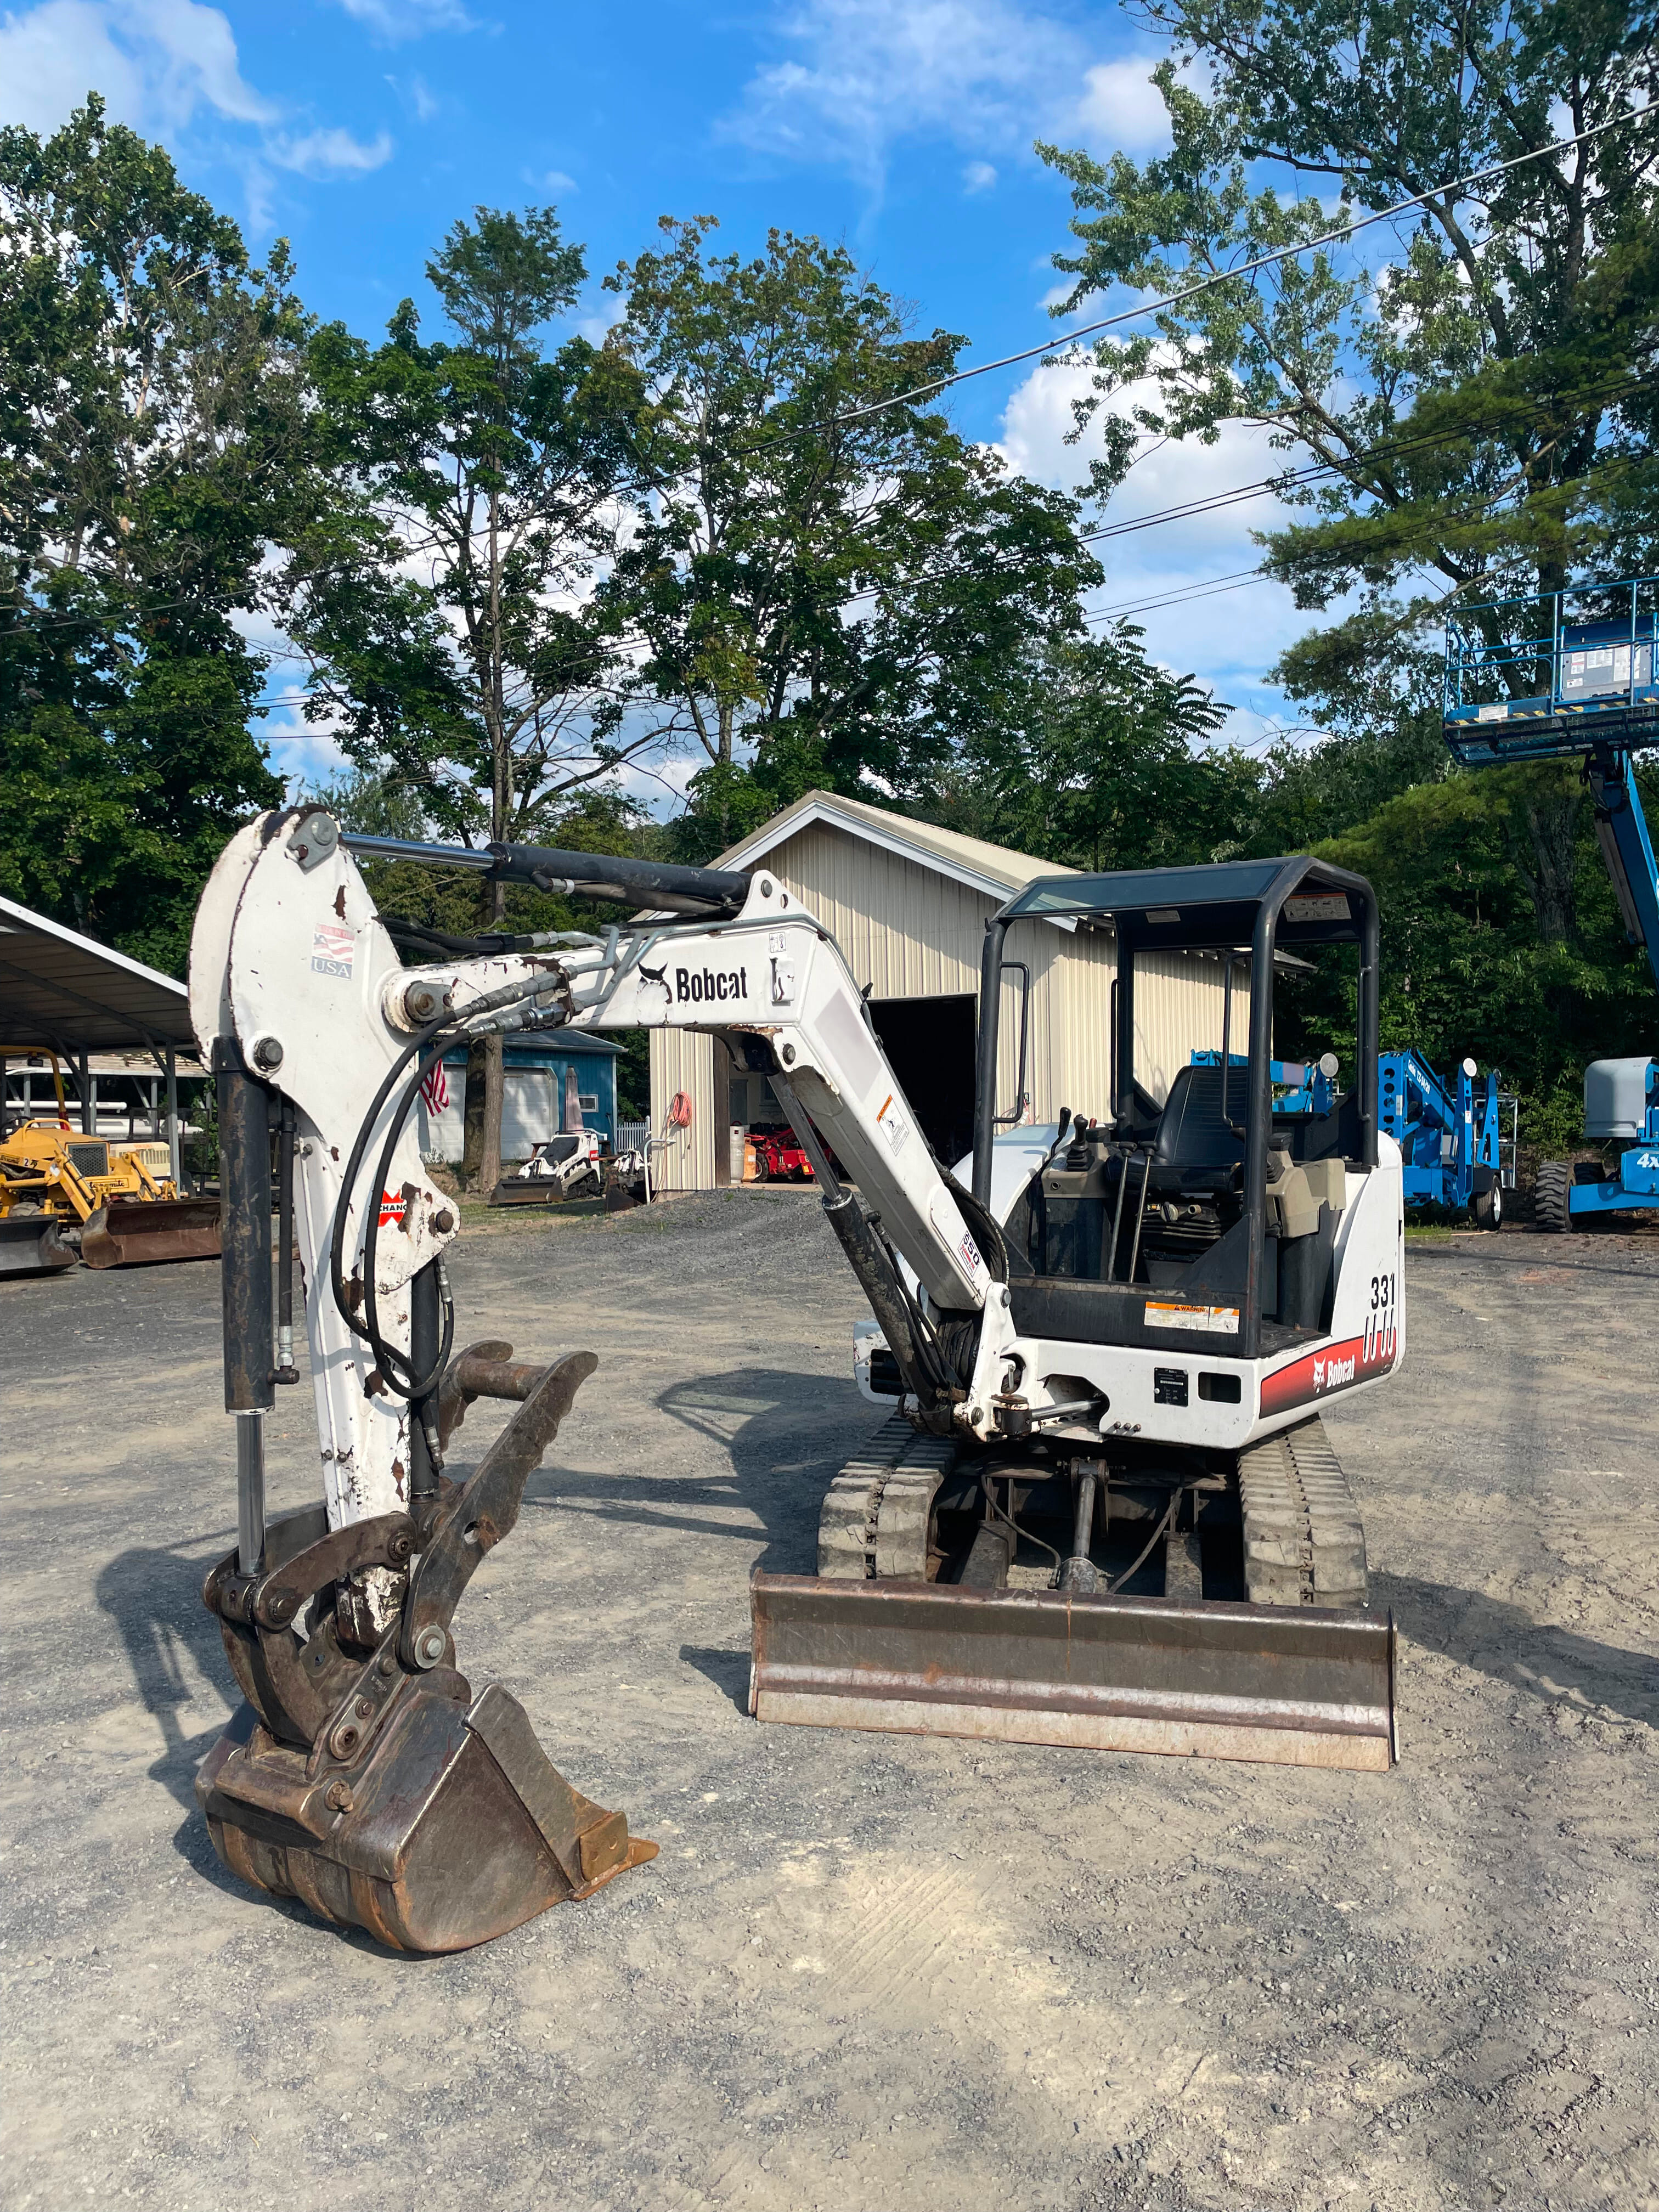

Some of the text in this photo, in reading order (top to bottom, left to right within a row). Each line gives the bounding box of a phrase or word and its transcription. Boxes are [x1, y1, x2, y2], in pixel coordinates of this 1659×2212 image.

[314, 958, 349, 977] USA
[676, 967, 748, 1003] Bobcat
[24, 1158, 29, 1166] 2
[963, 1234, 980, 1266] $50
[1371, 1274, 1395, 1310] 331
[1326, 1355, 1355, 1389] Bobcat
